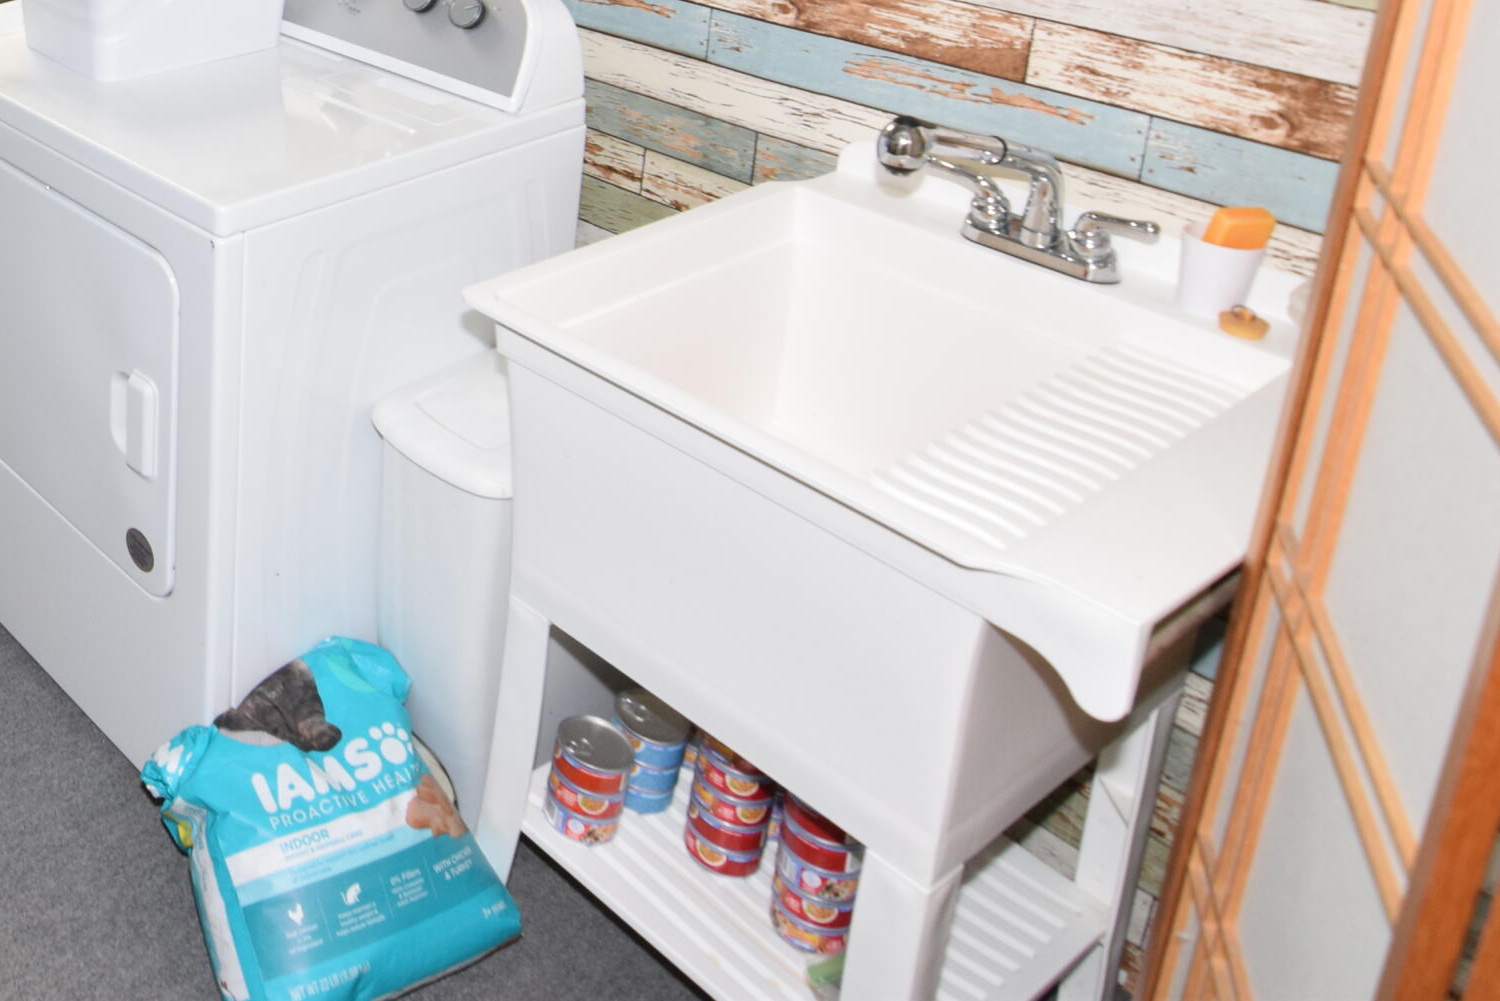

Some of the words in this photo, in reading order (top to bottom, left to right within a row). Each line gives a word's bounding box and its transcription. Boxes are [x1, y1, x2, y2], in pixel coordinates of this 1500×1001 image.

[251, 737, 382, 814] IAMS
[269, 790, 368, 831] PROACTIVE
[280, 828, 330, 855] INDOOR
